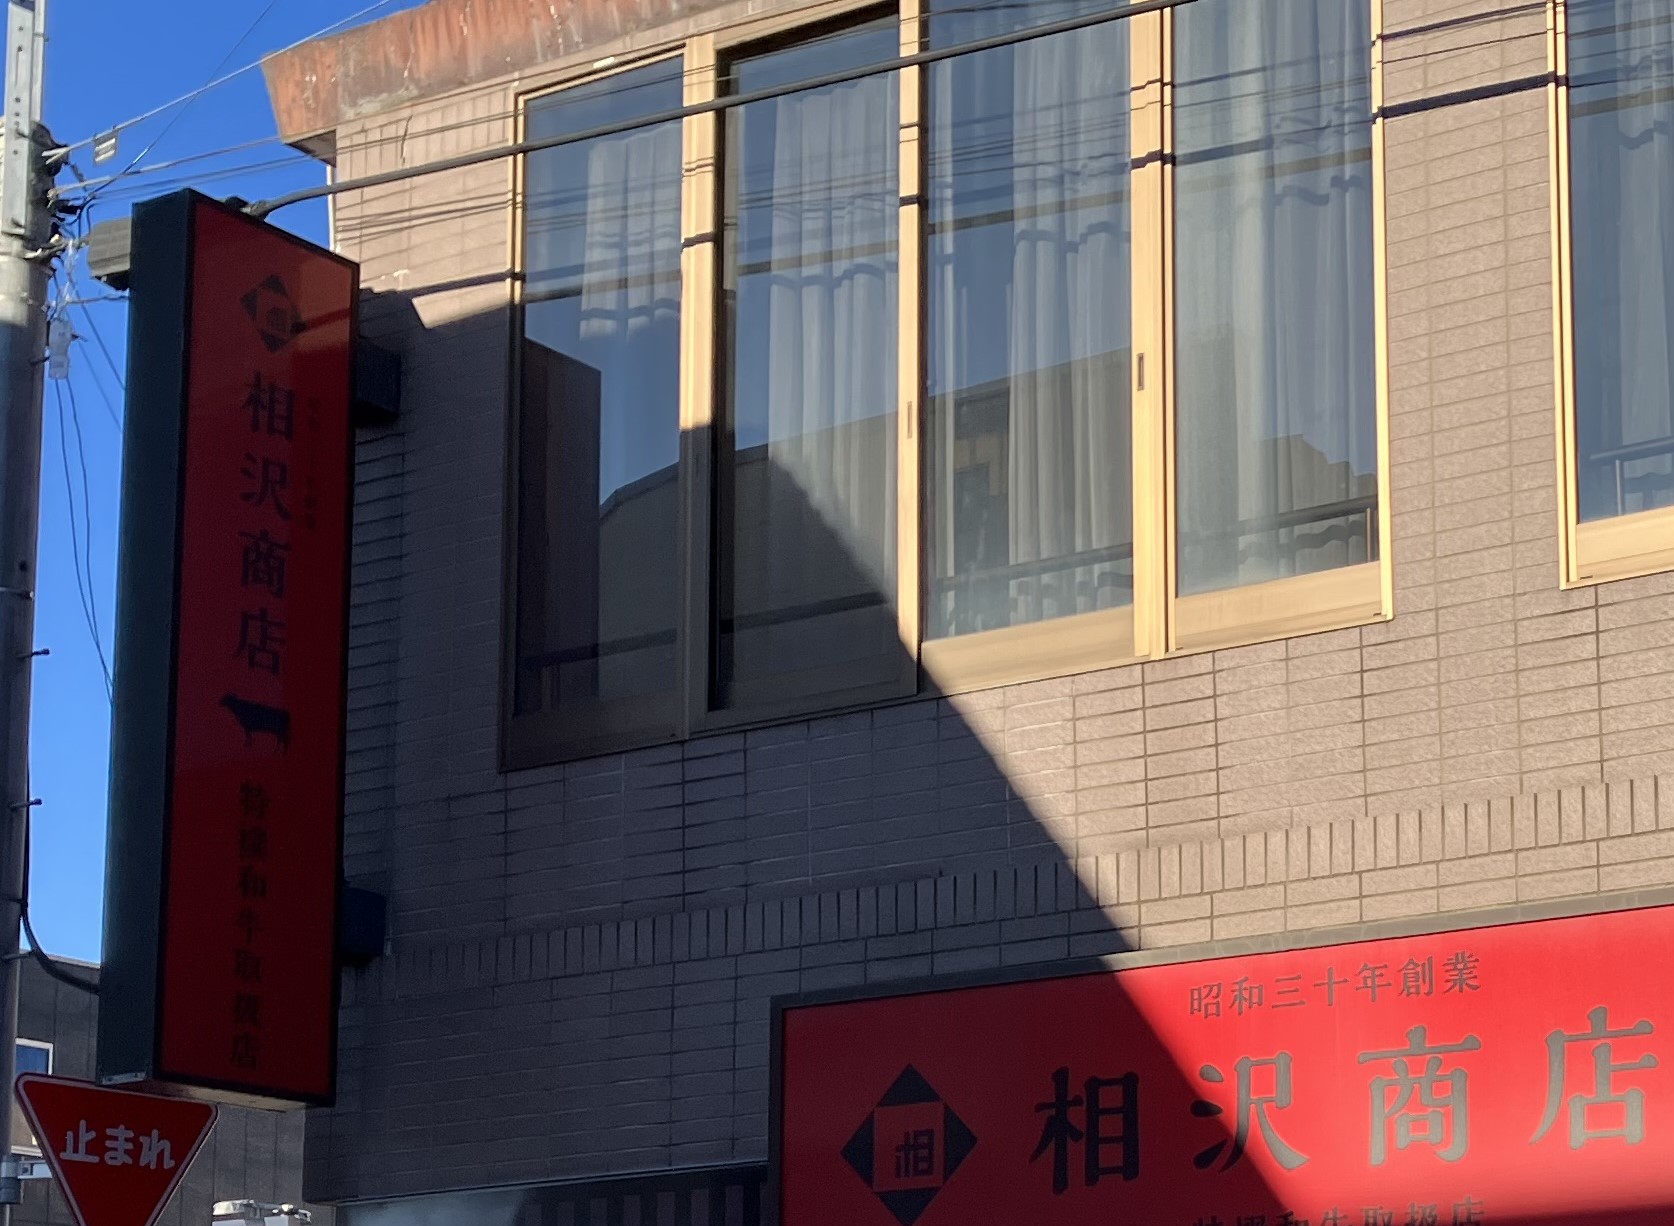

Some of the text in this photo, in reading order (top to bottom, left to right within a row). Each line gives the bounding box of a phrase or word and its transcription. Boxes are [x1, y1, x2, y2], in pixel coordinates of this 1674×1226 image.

[233, 372, 296, 676] 相沢商店
[1189, 950, 1482, 1019] 昭和三十年創業
[60, 1119, 175, 1170] 止まれ
[1029, 1005, 1657, 1194] 相沢商店
